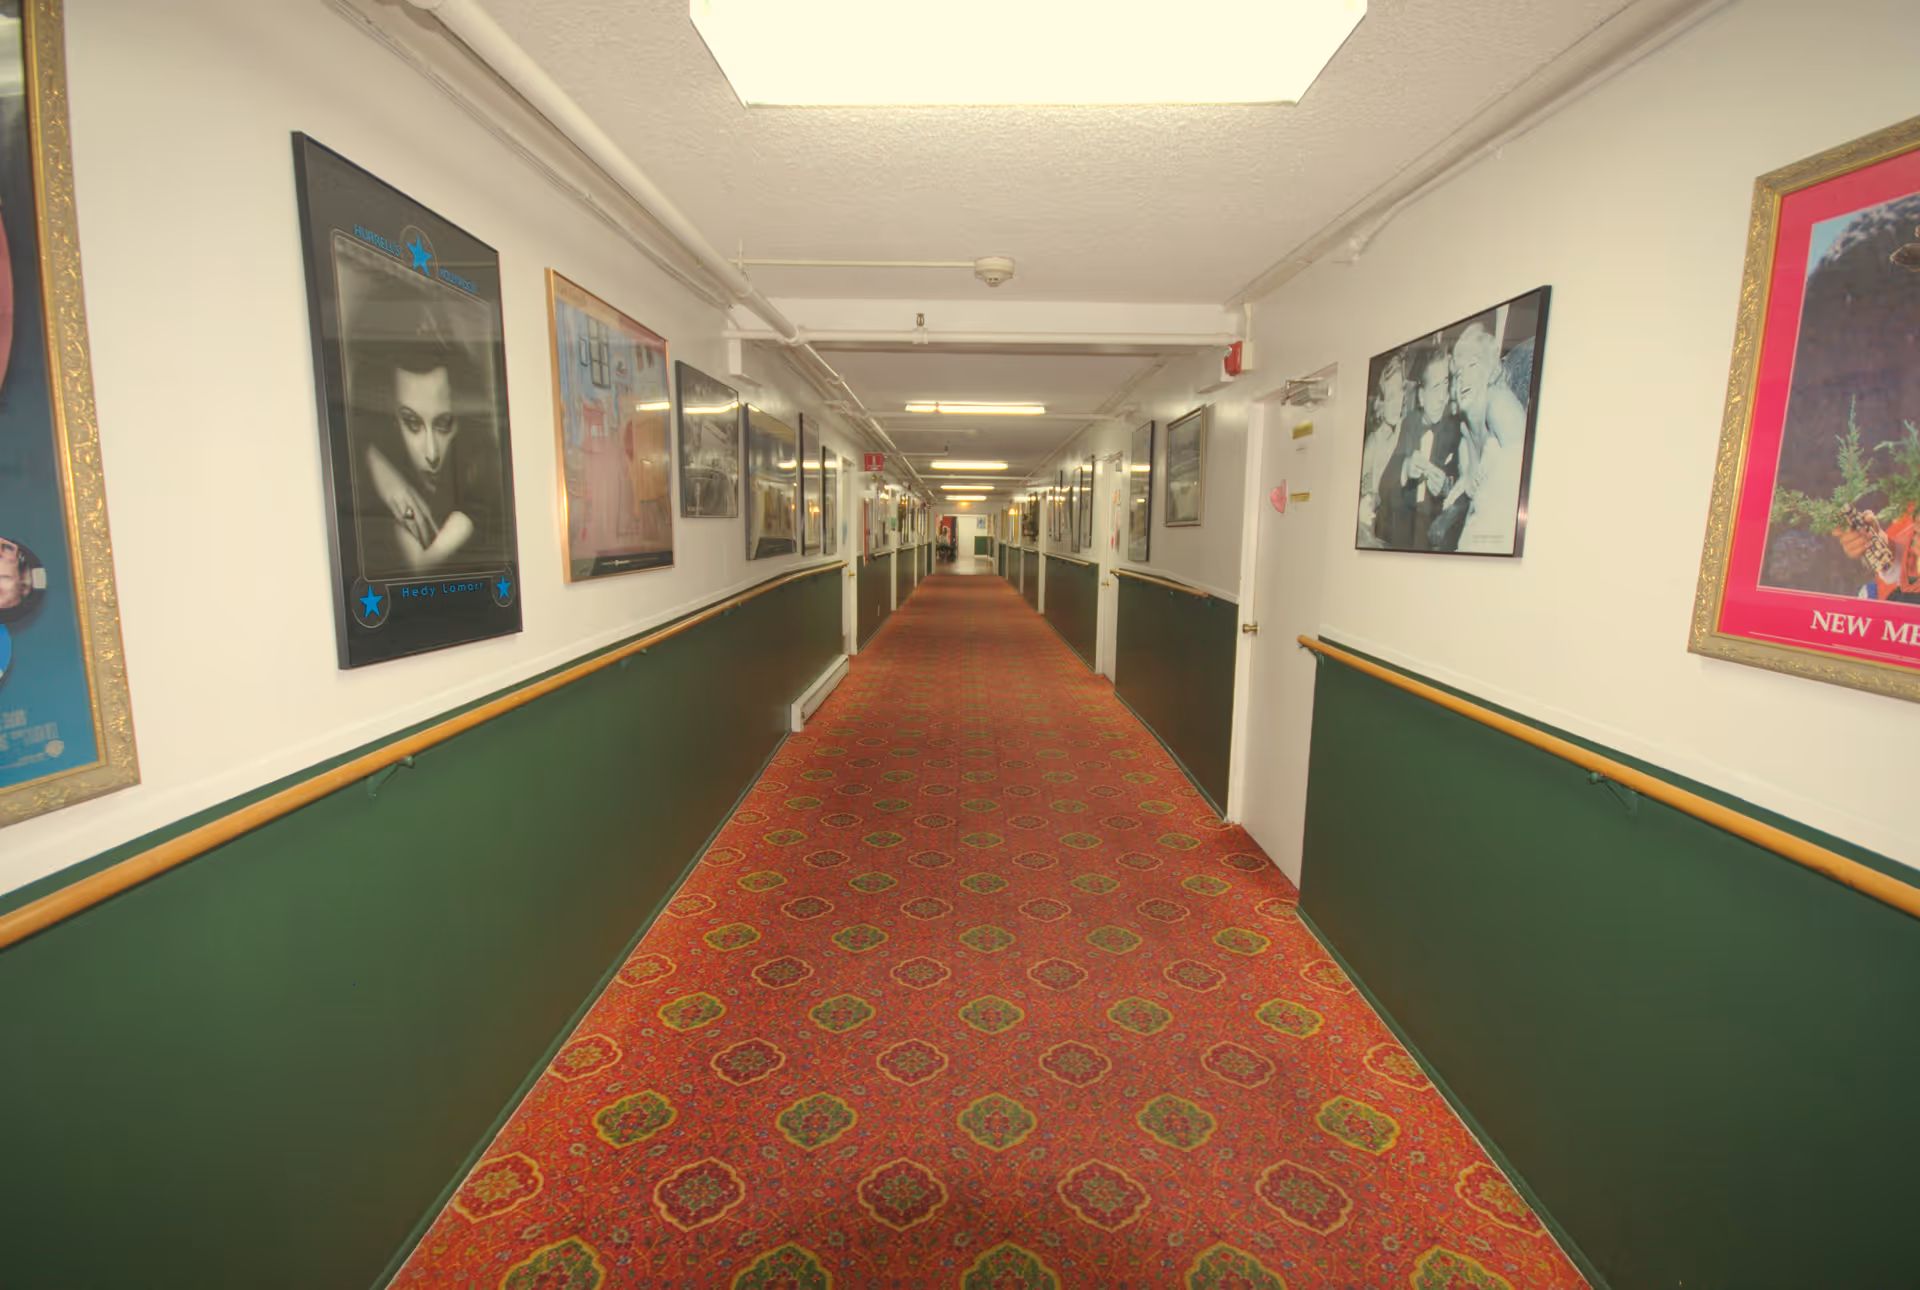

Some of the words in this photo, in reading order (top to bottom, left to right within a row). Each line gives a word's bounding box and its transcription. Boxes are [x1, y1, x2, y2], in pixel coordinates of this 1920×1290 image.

[402, 585, 435, 598] Hedy
[443, 582, 483, 594] Lamarr
[1810, 609, 1872, 637] NEW
